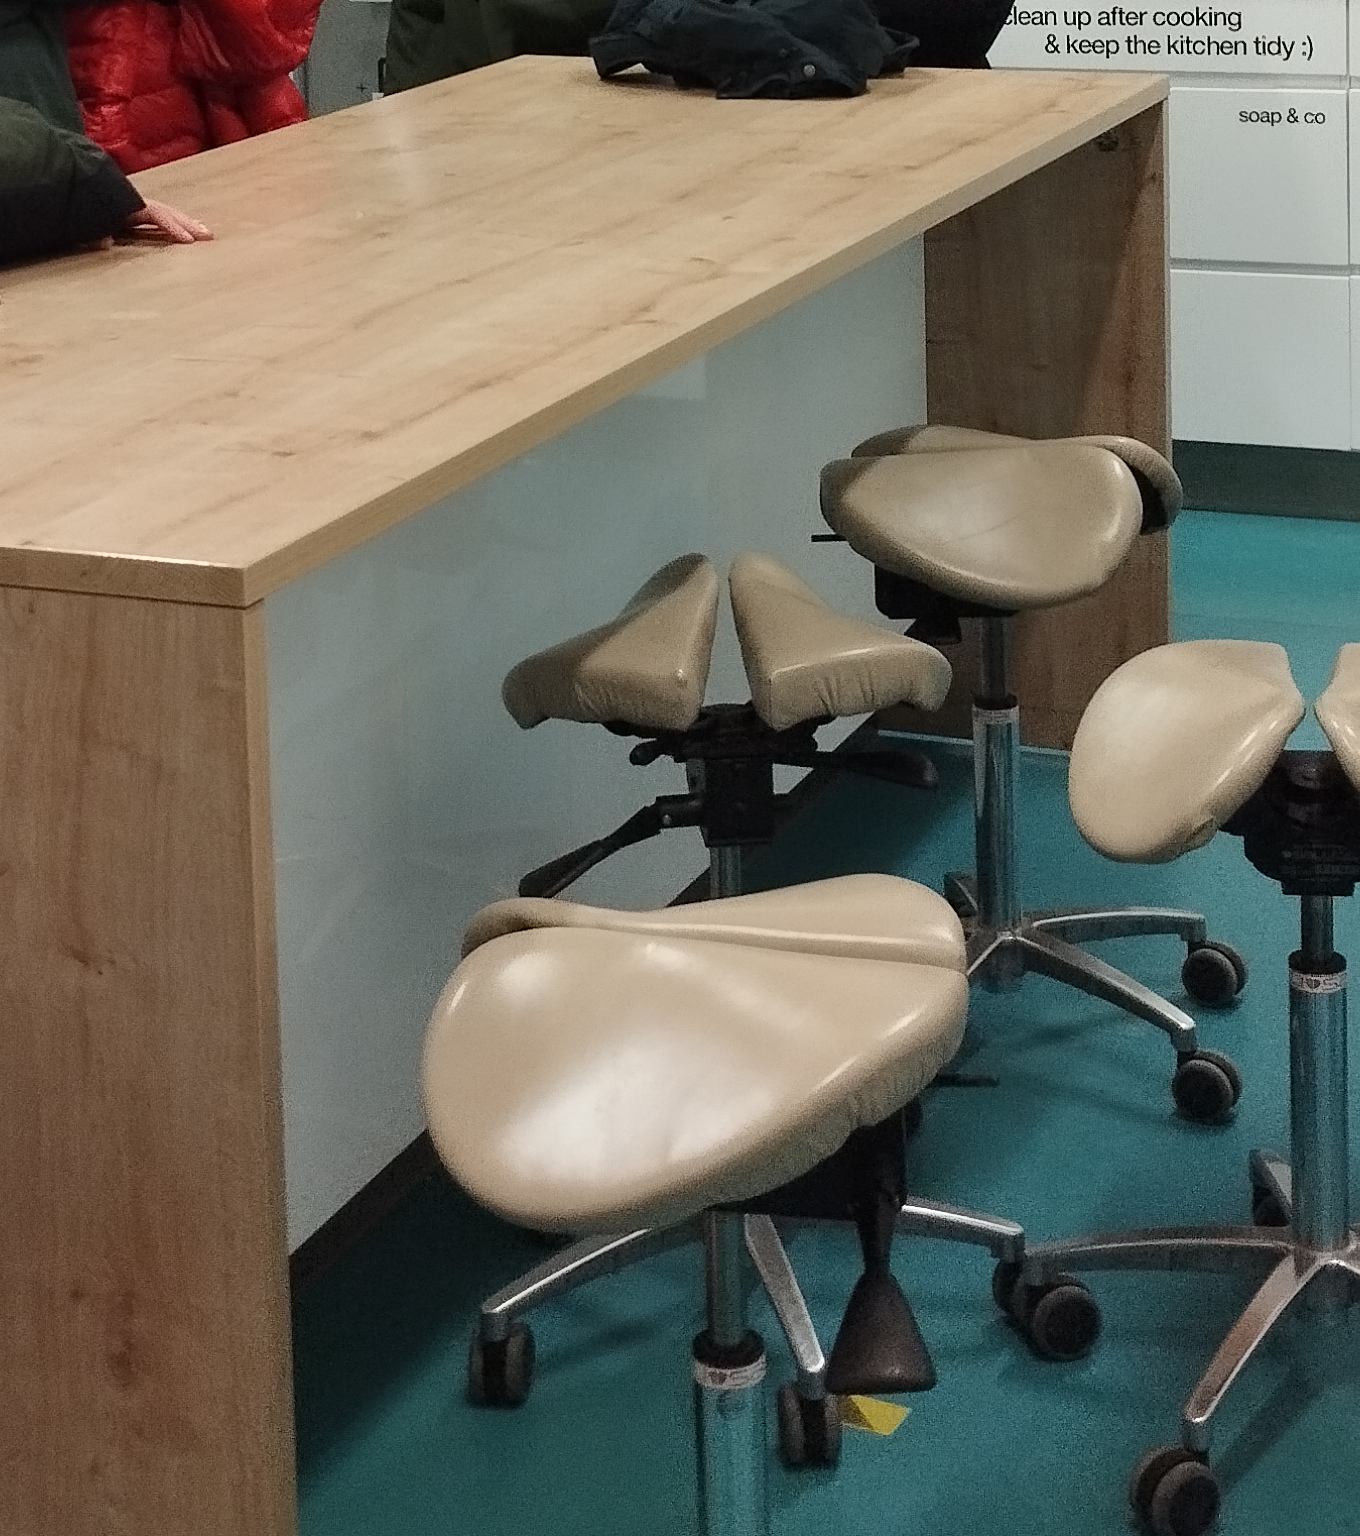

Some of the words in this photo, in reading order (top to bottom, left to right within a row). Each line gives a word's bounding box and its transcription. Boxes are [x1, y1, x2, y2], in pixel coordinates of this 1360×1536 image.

[1004, 5, 1057, 27] clean
[1064, 10, 1091, 30] up
[1097, 7, 1148, 27] after
[1153, 6, 1241, 32] cooking
[1044, 34, 1061, 54] &
[1066, 34, 1120, 59] keep
[1125, 36, 1161, 55] the
[1167, 35, 1247, 56] kitchen
[1253, 35, 1295, 61] tidy
[1239, 109, 1282, 127] soap
[1286, 108, 1300, 124] &
[1304, 111, 1326, 124] co
